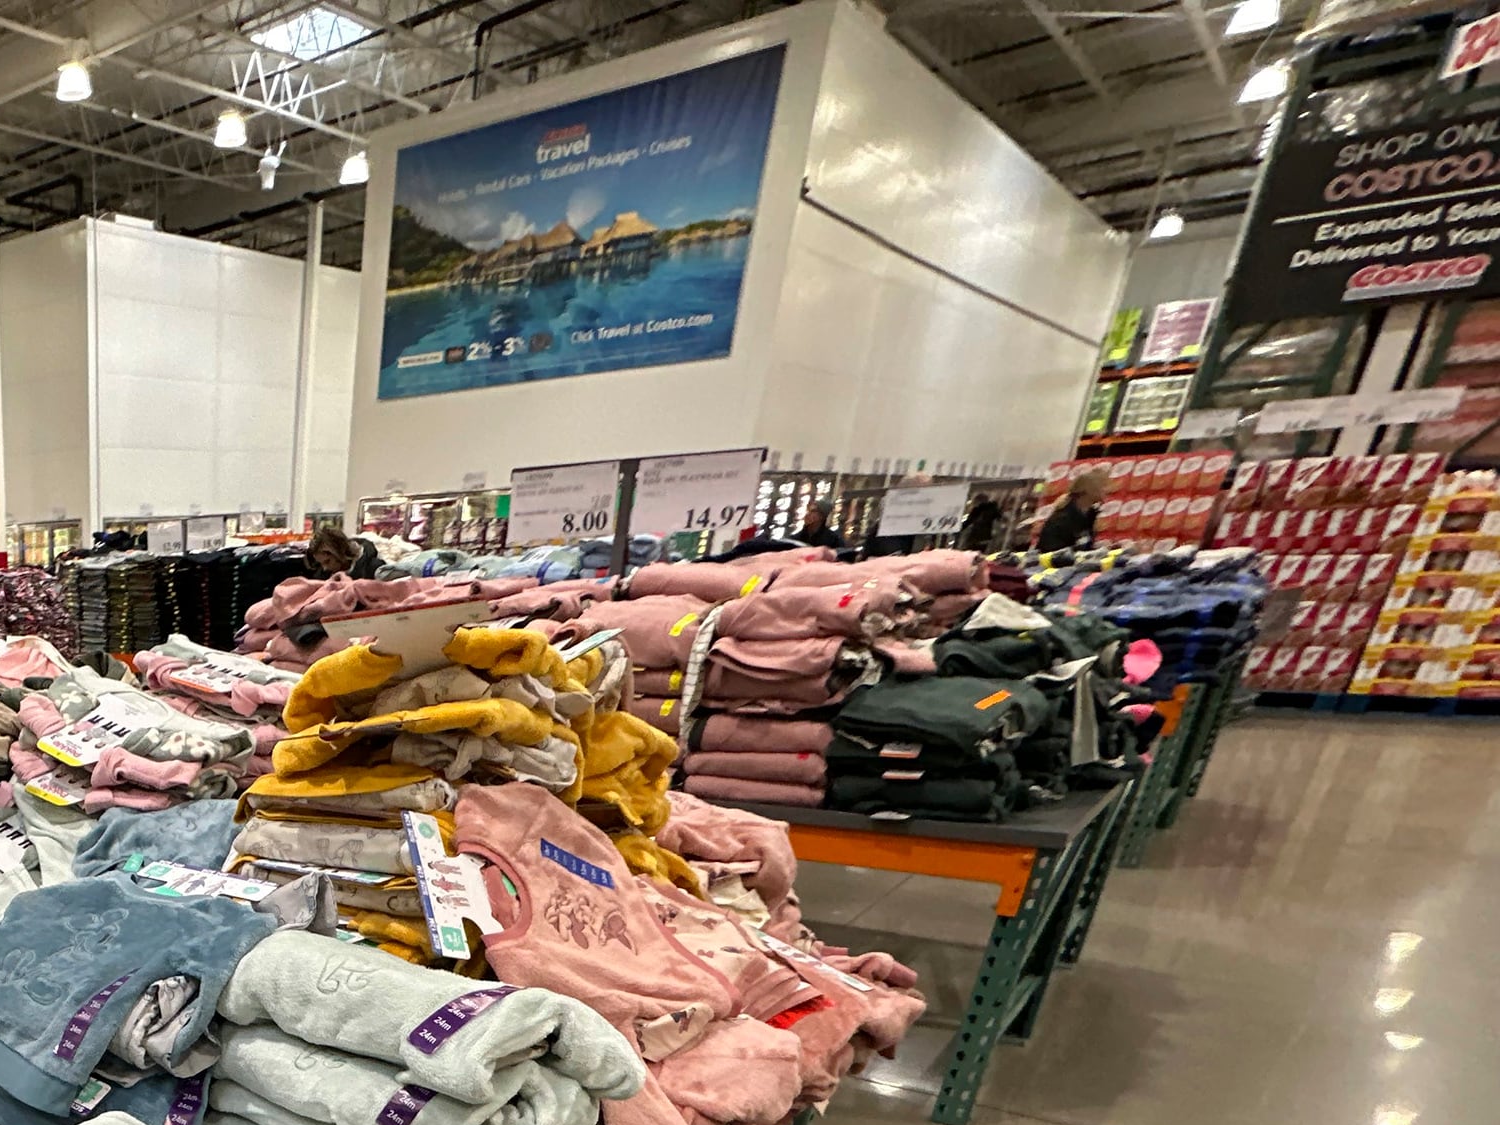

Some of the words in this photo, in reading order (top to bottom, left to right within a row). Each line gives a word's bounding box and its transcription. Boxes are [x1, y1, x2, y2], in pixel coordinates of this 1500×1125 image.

[536, 134, 591, 164] travel
[540, 160, 586, 181] Vacation
[587, 150, 640, 172] Packages
[649, 135, 692, 156] Cruises
[1334, 132, 1428, 168] SHOP
[1314, 205, 1445, 243] Expanded
[1289, 236, 1408, 270] Delivered
[1411, 235, 1440, 252] to
[1347, 253, 1492, 290] COSTCO
[570, 330, 594, 345] Click
[598, 323, 631, 341] Travel
[646, 313, 714, 333] Costco.com
[562, 511, 608, 533] 8.00
[684, 505, 749, 529] 14.97
[434, 1016, 451, 1031] 24m
[447, 1006, 466, 1019] 24m
[419, 1029, 437, 1044] 24m
[399, 1094, 416, 1110] 24m
[171, 1114, 188, 1125] 24m
[386, 1110, 404, 1125] 24m
